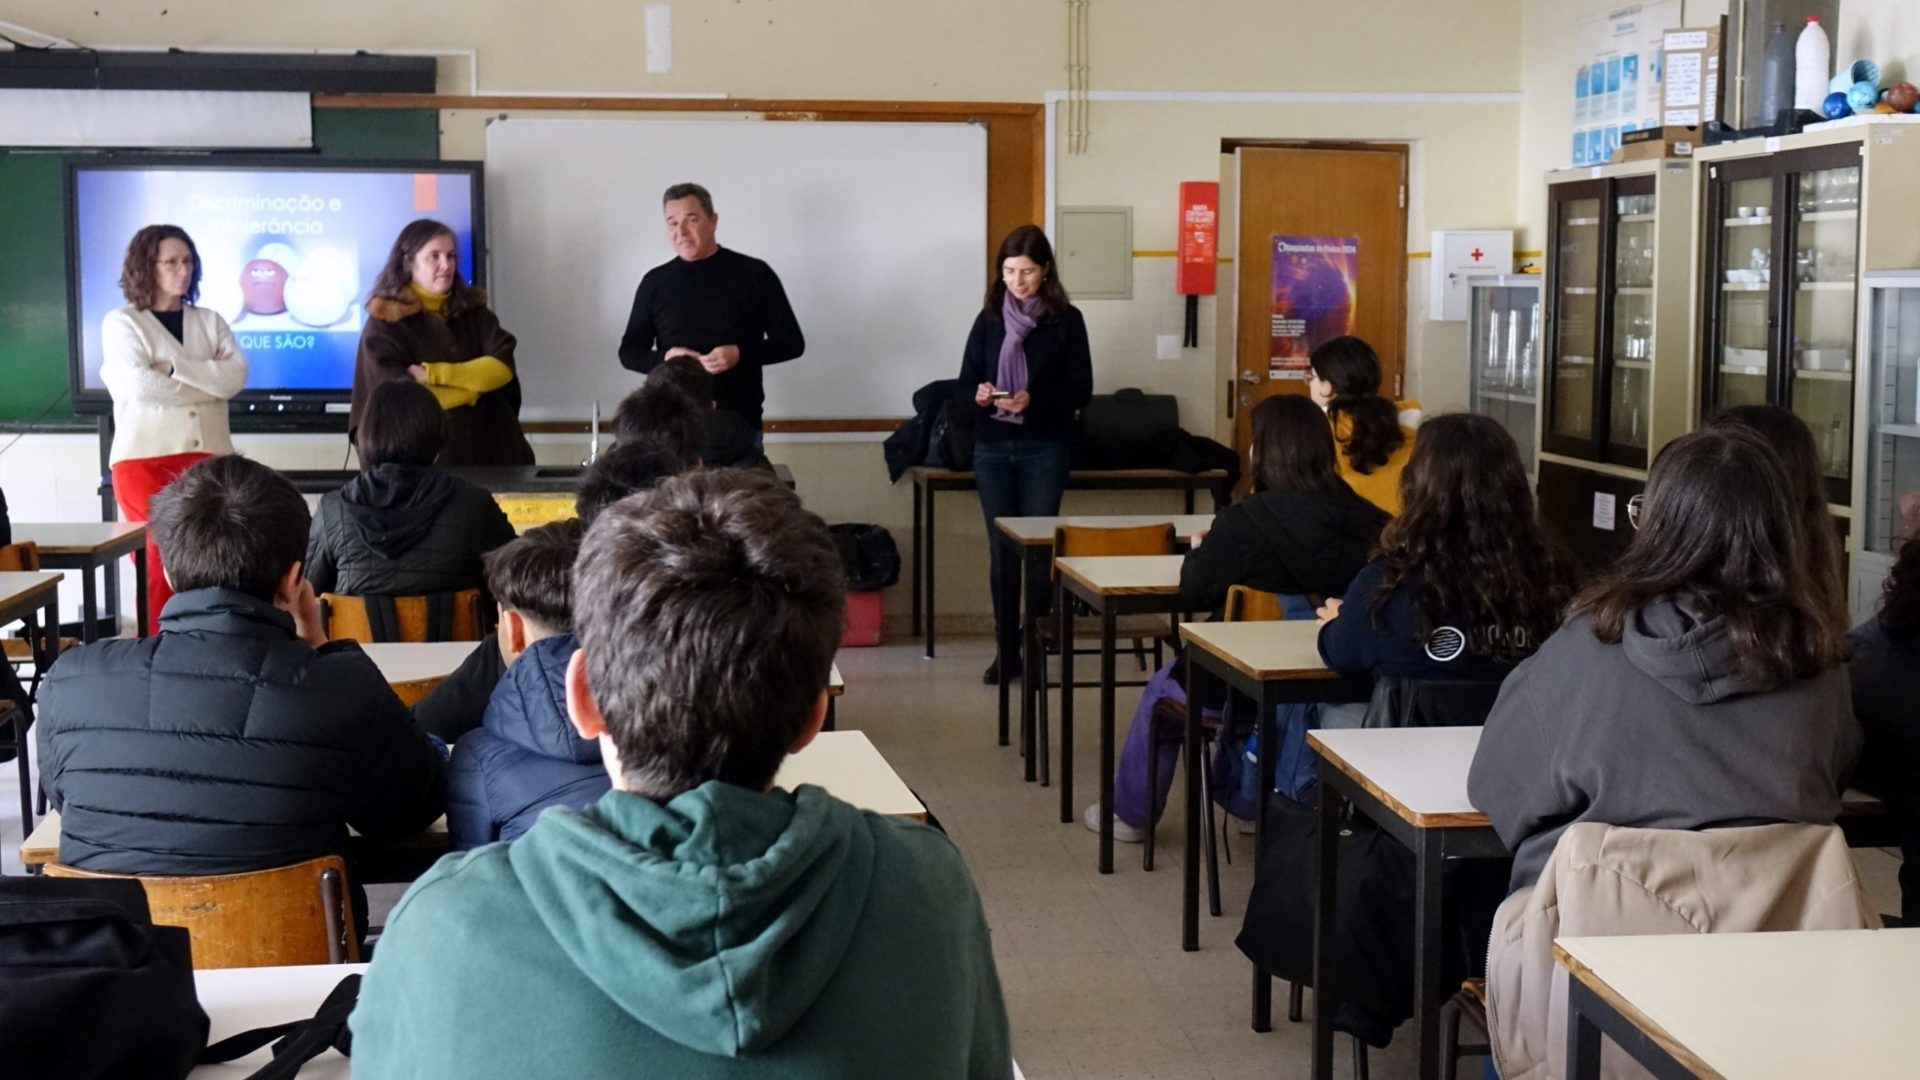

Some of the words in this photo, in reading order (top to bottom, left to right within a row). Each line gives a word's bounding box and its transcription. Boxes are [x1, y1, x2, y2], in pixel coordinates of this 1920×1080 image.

[189, 193, 325, 214] Discriminação
[329, 198, 342, 212] e
[240, 335, 270, 350] QUE
[275, 333, 315, 349] SÃO?
